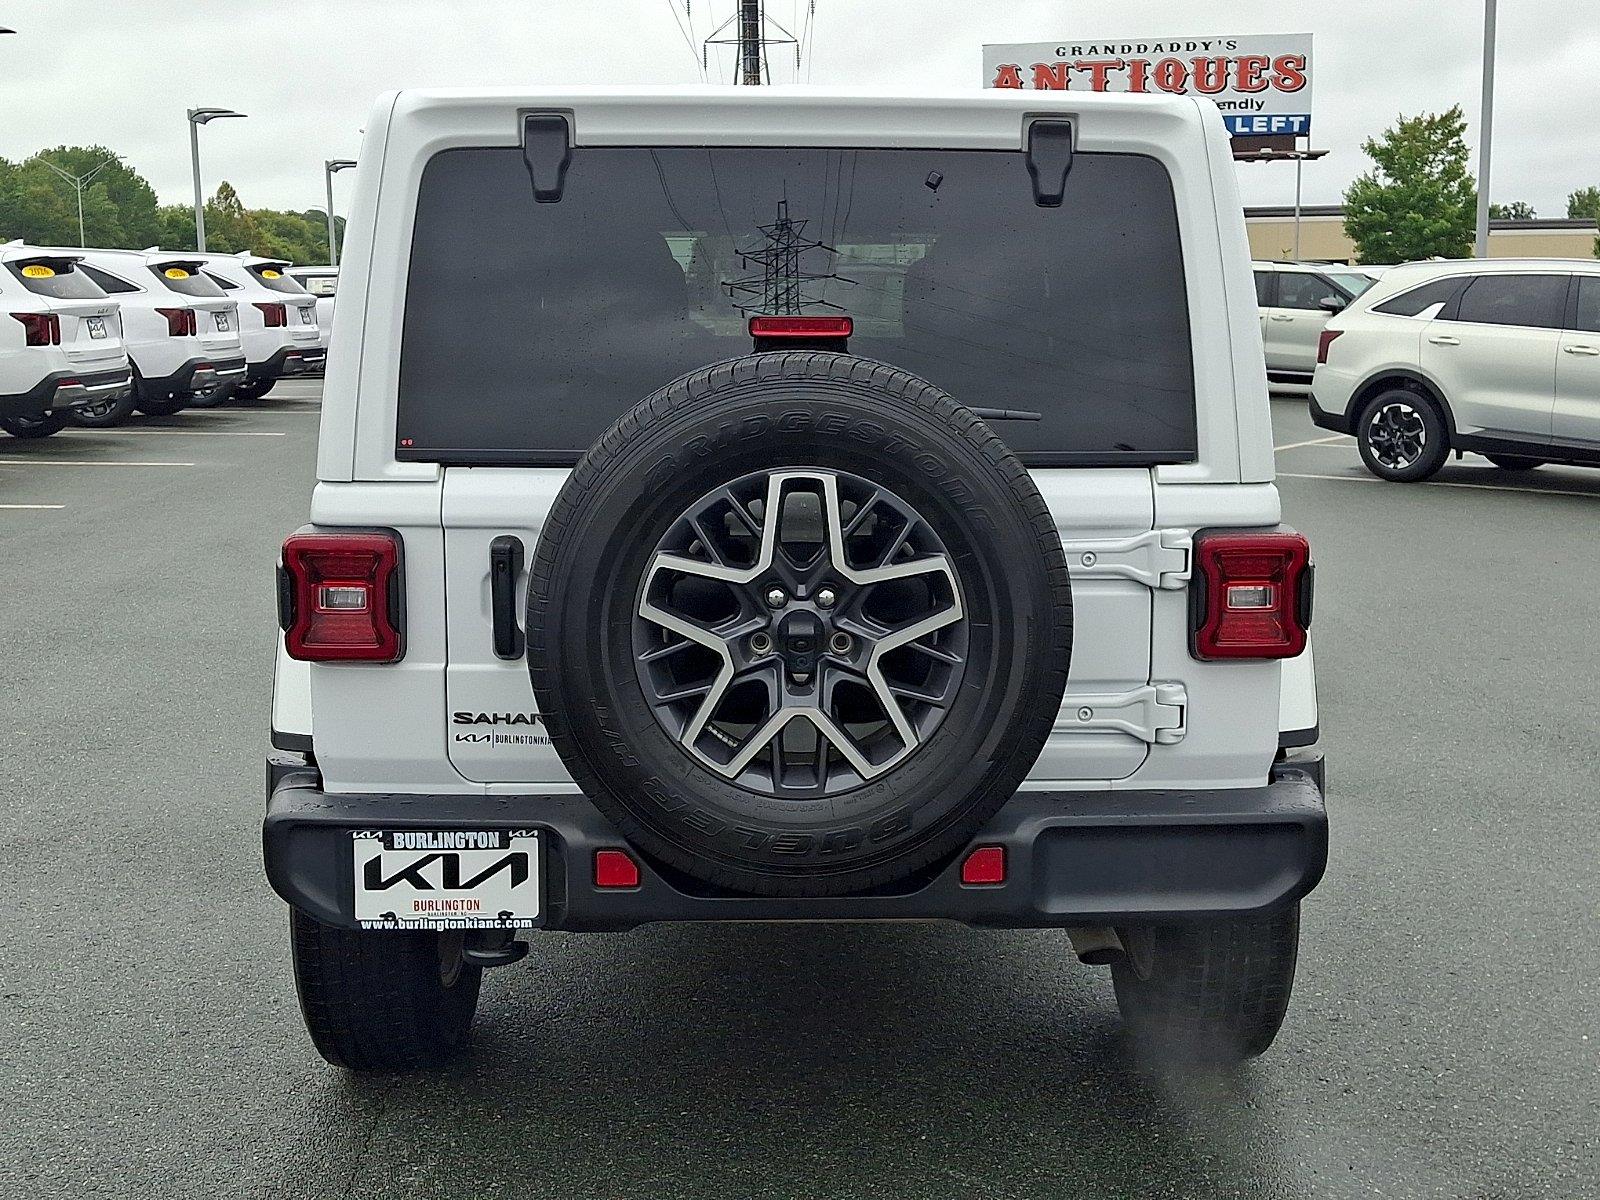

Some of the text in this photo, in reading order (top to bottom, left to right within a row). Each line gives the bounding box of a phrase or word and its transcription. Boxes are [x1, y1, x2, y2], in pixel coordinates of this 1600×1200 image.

[1055, 40, 1237, 57] GRANDDADDY'S
[992, 53, 1307, 95] ANTIQUES
[1216, 98, 1265, 111] endly
[1235, 116, 1305, 132] LEFT
[393, 832, 500, 849] BURLINGTON
[364, 853, 529, 890] KIA
[413, 899, 480, 911] BURLINGTON
[361, 918, 533, 931] www.burlingtonkianc.com
